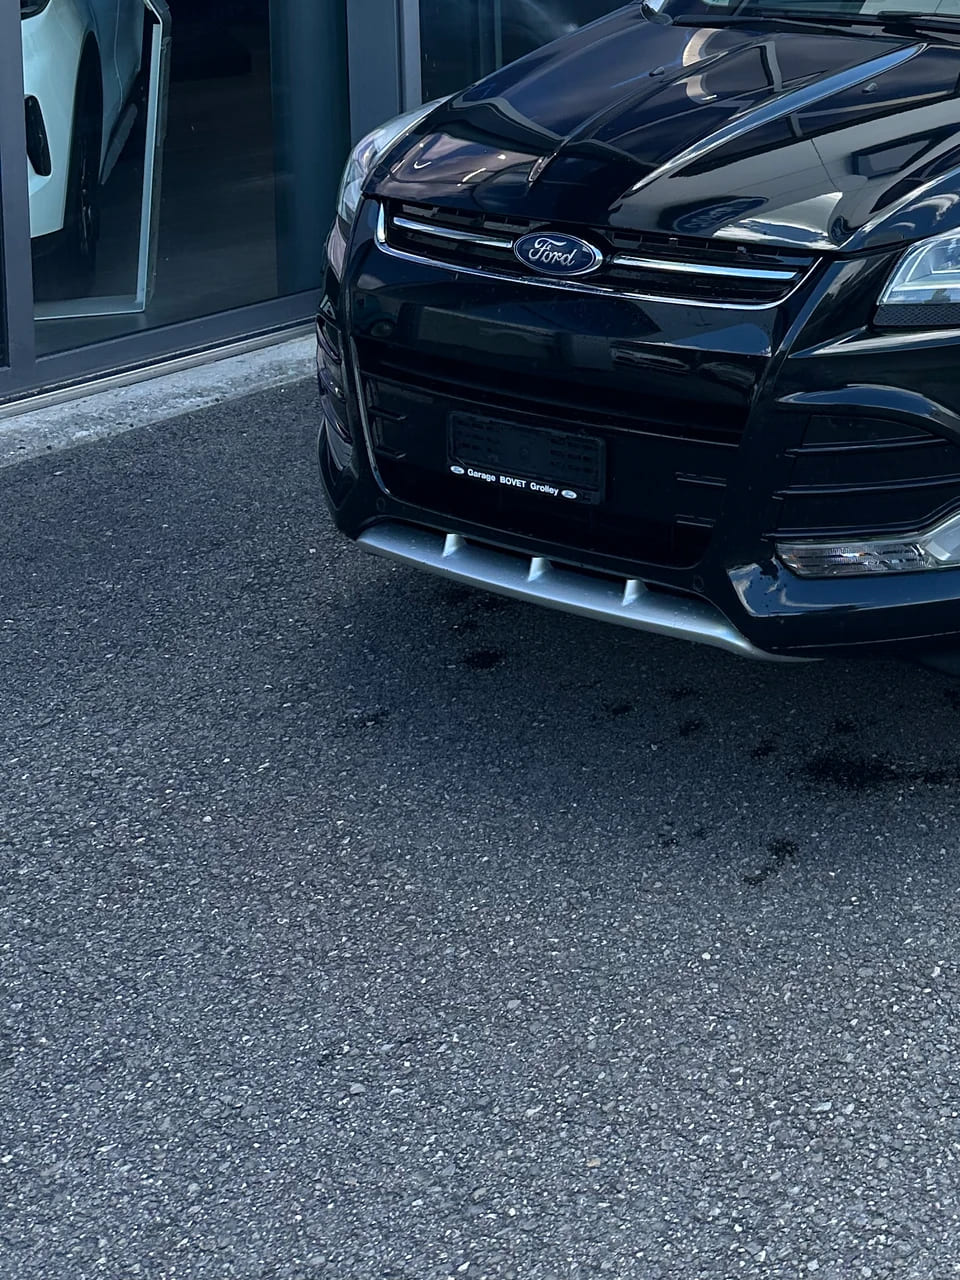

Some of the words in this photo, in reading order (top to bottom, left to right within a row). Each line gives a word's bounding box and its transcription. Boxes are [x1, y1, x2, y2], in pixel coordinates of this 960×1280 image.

[528, 237, 578, 267] Ford
[466, 468, 496, 483] Garage
[499, 475, 527, 489] BOVET
[529, 482, 559, 497] Grolley
